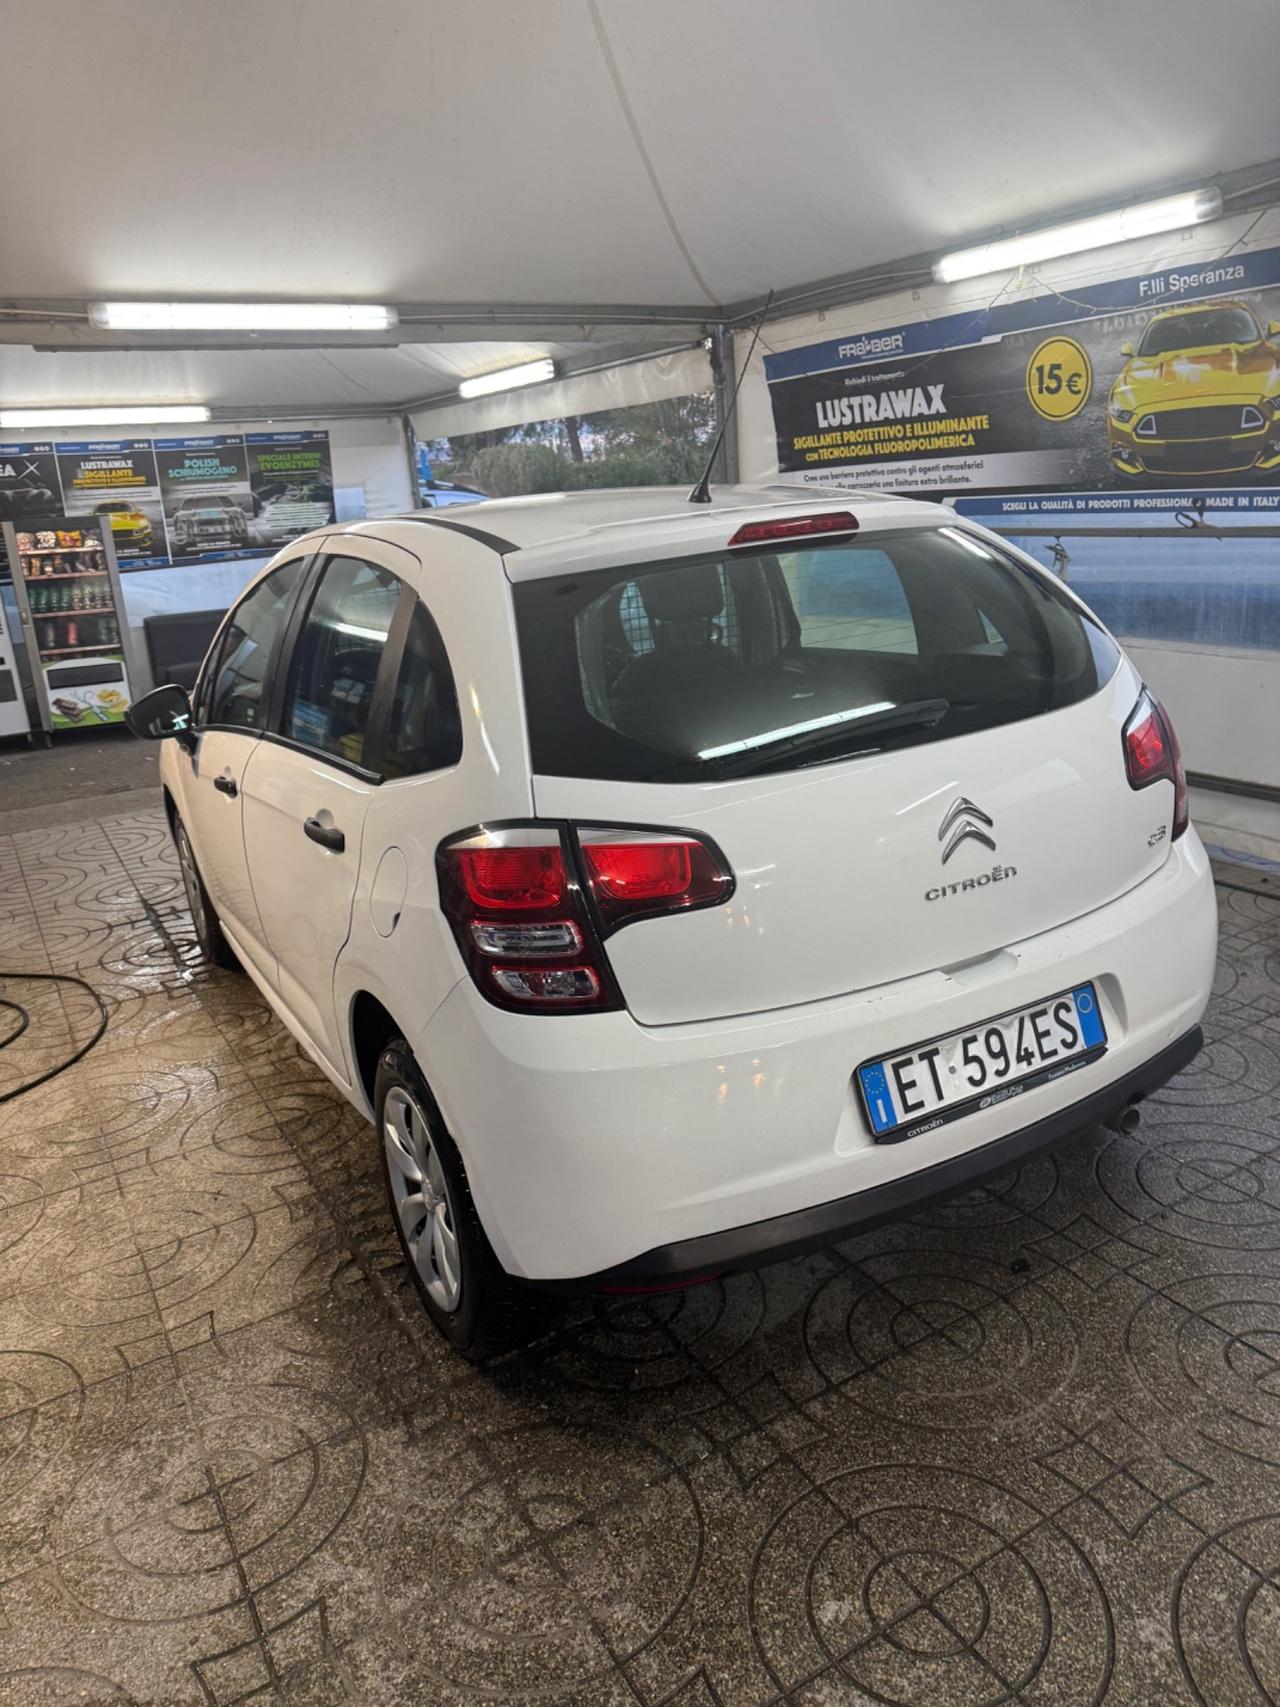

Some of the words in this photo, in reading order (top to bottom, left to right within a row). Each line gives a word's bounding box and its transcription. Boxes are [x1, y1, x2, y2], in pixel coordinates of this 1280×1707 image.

[1169, 264, 1246, 293] Speranza
[815, 384, 947, 428] LUSTRAWAX
[793, 432, 842, 450] SIGILLANTE
[843, 425, 904, 443] PROTETTIVO
[906, 424, 912, 436] E
[914, 415, 990, 435] ILLUMINANTE
[818, 446, 873, 461] TECNOLOGIA
[874, 434, 975, 455] FLUOROPOLIMERICA
[80, 460, 134, 469] LUSTRAWAX
[184, 457, 220, 468] POLISH
[830, 470, 854, 481] barriera
[855, 468, 885, 479] protettiva
[886, 467, 906, 476] contro
[908, 465, 917, 476] gli
[918, 463, 940, 475] agenti
[942, 460, 984, 472] atmosferici
[84, 469, 133, 478] SIGILLANTE
[882, 480, 894, 488] una
[895, 476, 919, 487] finitura
[920, 477, 938, 485] extra
[939, 474, 972, 484] brillante.
[1002, 501, 1027, 511] SCEGLI
[1029, 501, 1039, 510] LA
[1041, 498, 1074, 510] QUALITÀ
[1076, 500, 1086, 509] DI
[1088, 499, 1131, 508] PRODOTTI
[1206, 497, 1235, 507] MADE
[1237, 496, 1249, 507] IN
[1253, 496, 1280, 507] ITALY
[891, 1047, 945, 1115] ET
[961, 1001, 1079, 1088] 594ES
